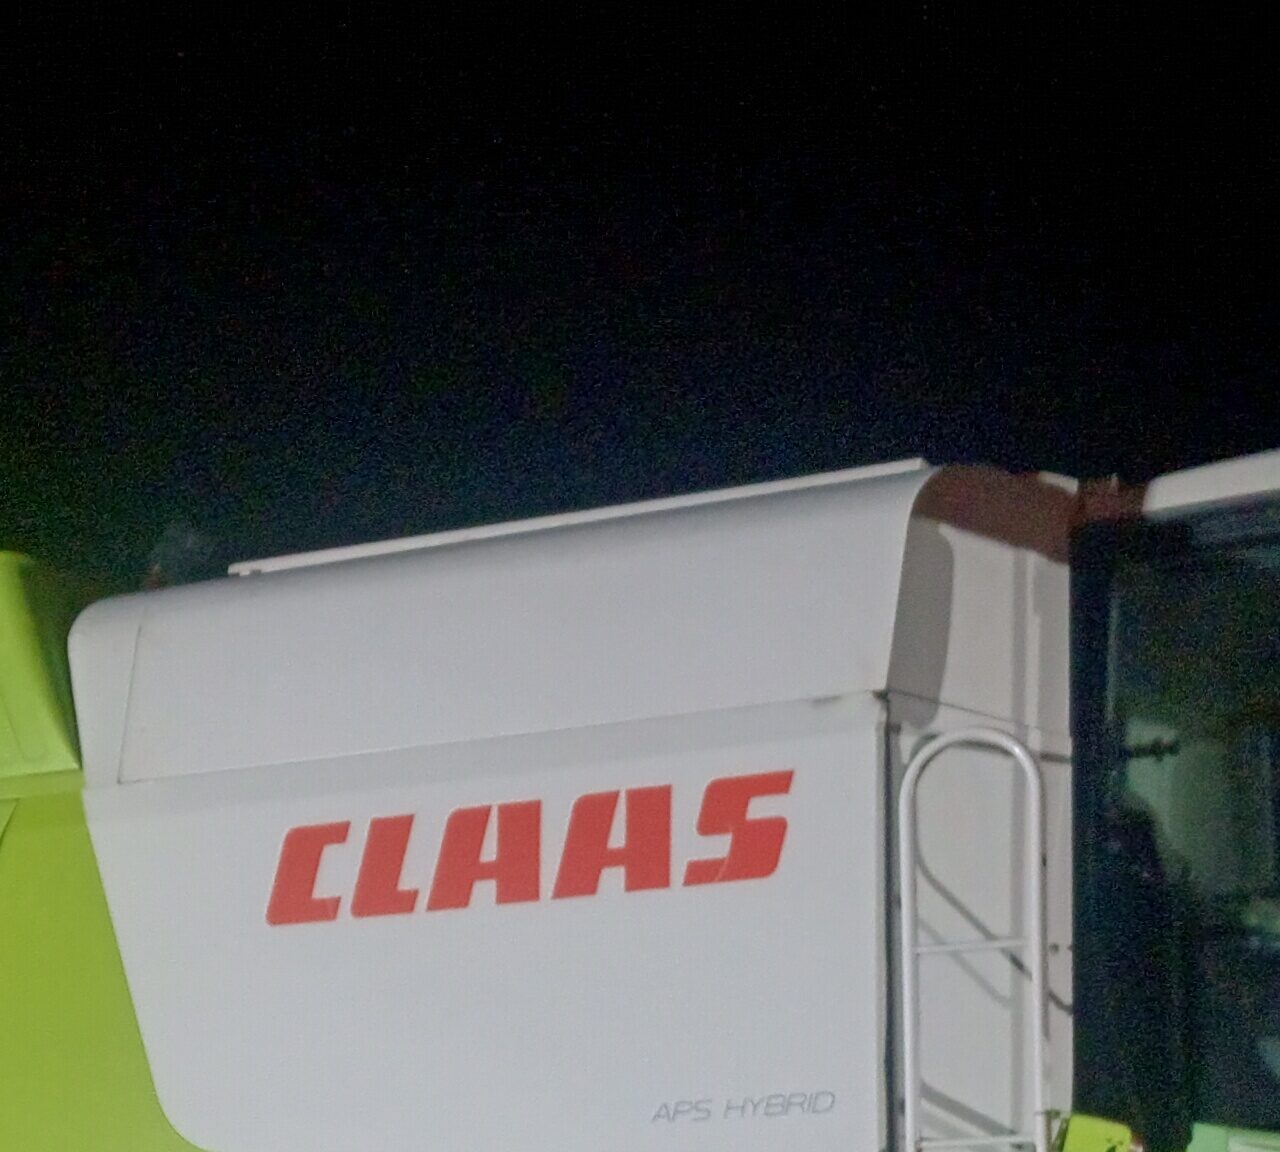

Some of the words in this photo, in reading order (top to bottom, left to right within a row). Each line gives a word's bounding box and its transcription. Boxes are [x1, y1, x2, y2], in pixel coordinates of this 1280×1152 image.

[265, 769, 795, 926] CLAAS
[651, 1098, 713, 1123] APS
[723, 1090, 836, 1119] HYBRID
